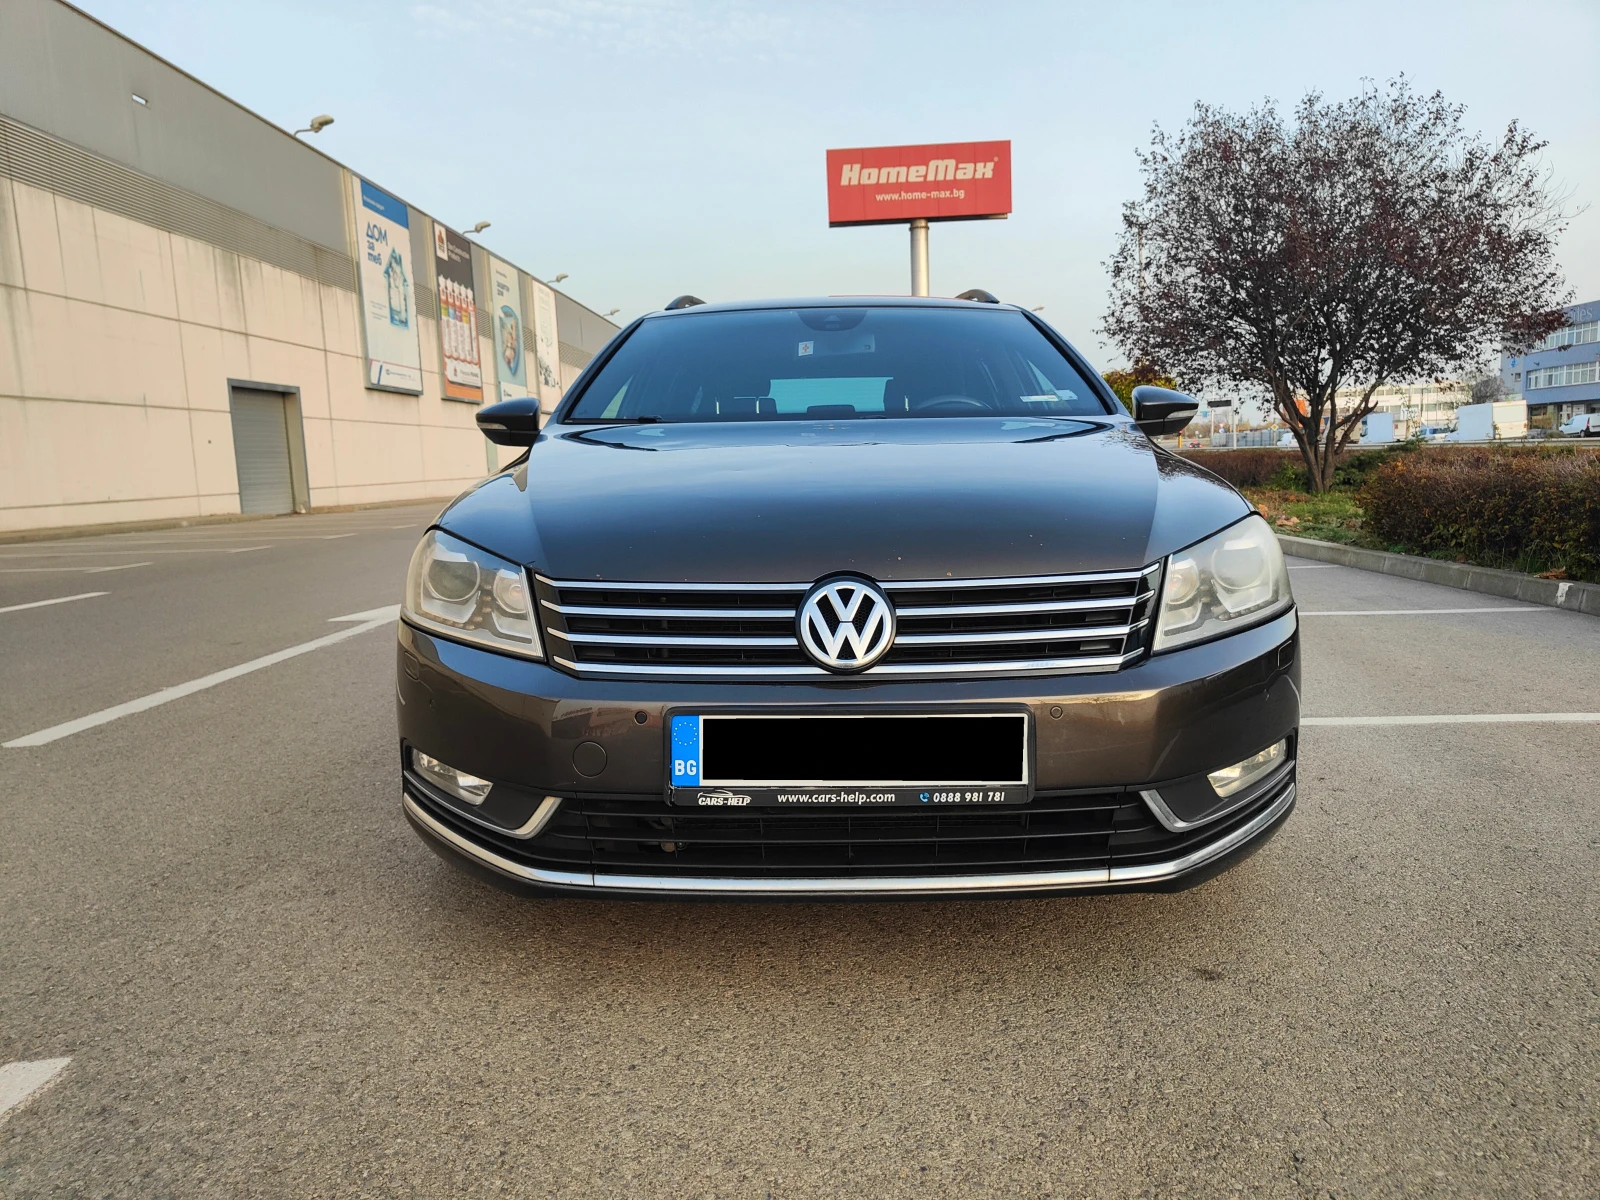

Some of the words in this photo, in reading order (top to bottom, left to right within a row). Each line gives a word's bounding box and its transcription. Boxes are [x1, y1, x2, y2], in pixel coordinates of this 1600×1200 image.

[840, 158, 995, 187] HomeMax
[875, 188, 966, 202] www.home-max.bg
[675, 760, 697, 776] BG
[698, 797, 752, 806] CARS-HELP
[777, 791, 896, 805] www.cars-help.com
[933, 792, 961, 803] 0888
[964, 792, 983, 802] 981
[987, 791, 1005, 802] 781
